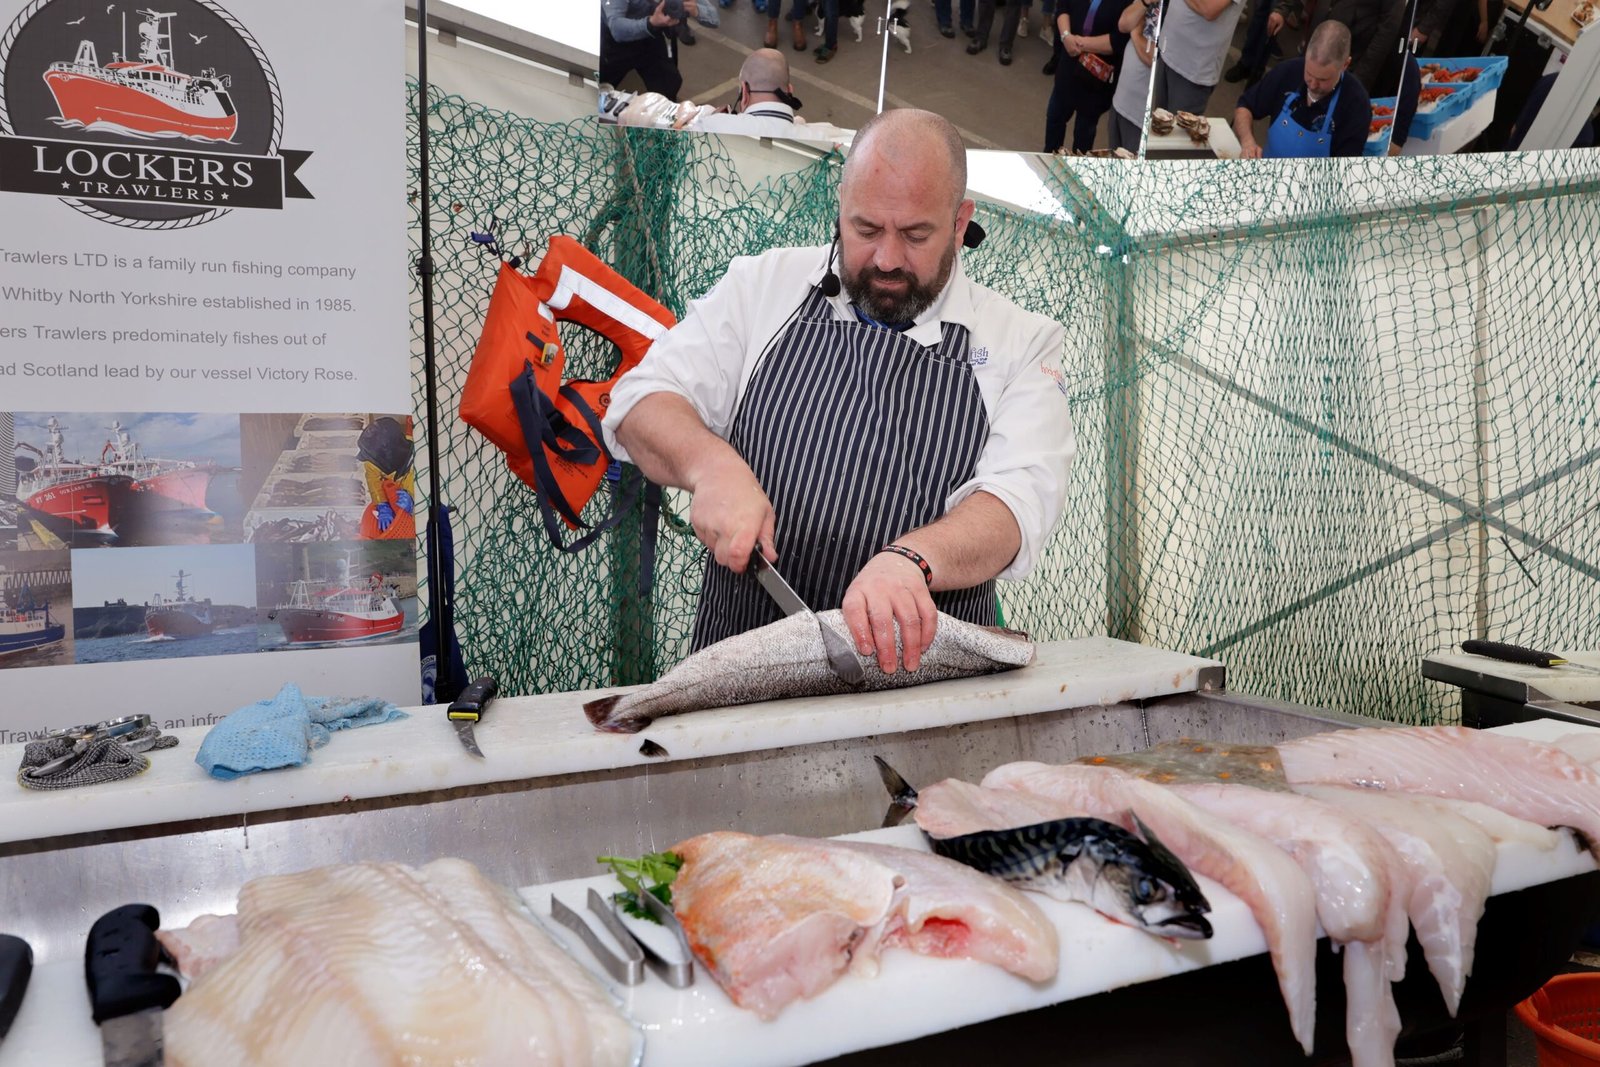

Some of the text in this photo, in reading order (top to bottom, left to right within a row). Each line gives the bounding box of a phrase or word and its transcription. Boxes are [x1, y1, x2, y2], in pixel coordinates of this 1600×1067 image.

[33, 145, 253, 188] LOCKERS
[79, 181, 214, 201] TRAWLERS
[0, 249, 356, 281] rawlers LTD is a family run fishing company
[2, 285, 356, 312] Whitby North Yorkshire established in 1985.
[33, 325, 106, 341] Trawlers
[113, 328, 228, 347] predominately
[233, 330, 278, 345] fishes
[284, 333, 307, 346] out
[312, 332, 327, 346] of
[23, 362, 98, 378] Scotland
[104, 363, 139, 378] lead
[145, 364, 164, 382] by
[170, 368, 196, 379] our
[202, 367, 251, 380] vessel
[257, 367, 309, 383] Victory
[315, 367, 358, 381] Rose.
[164, 718, 185, 730] an
[192, 713, 227, 727] infr
